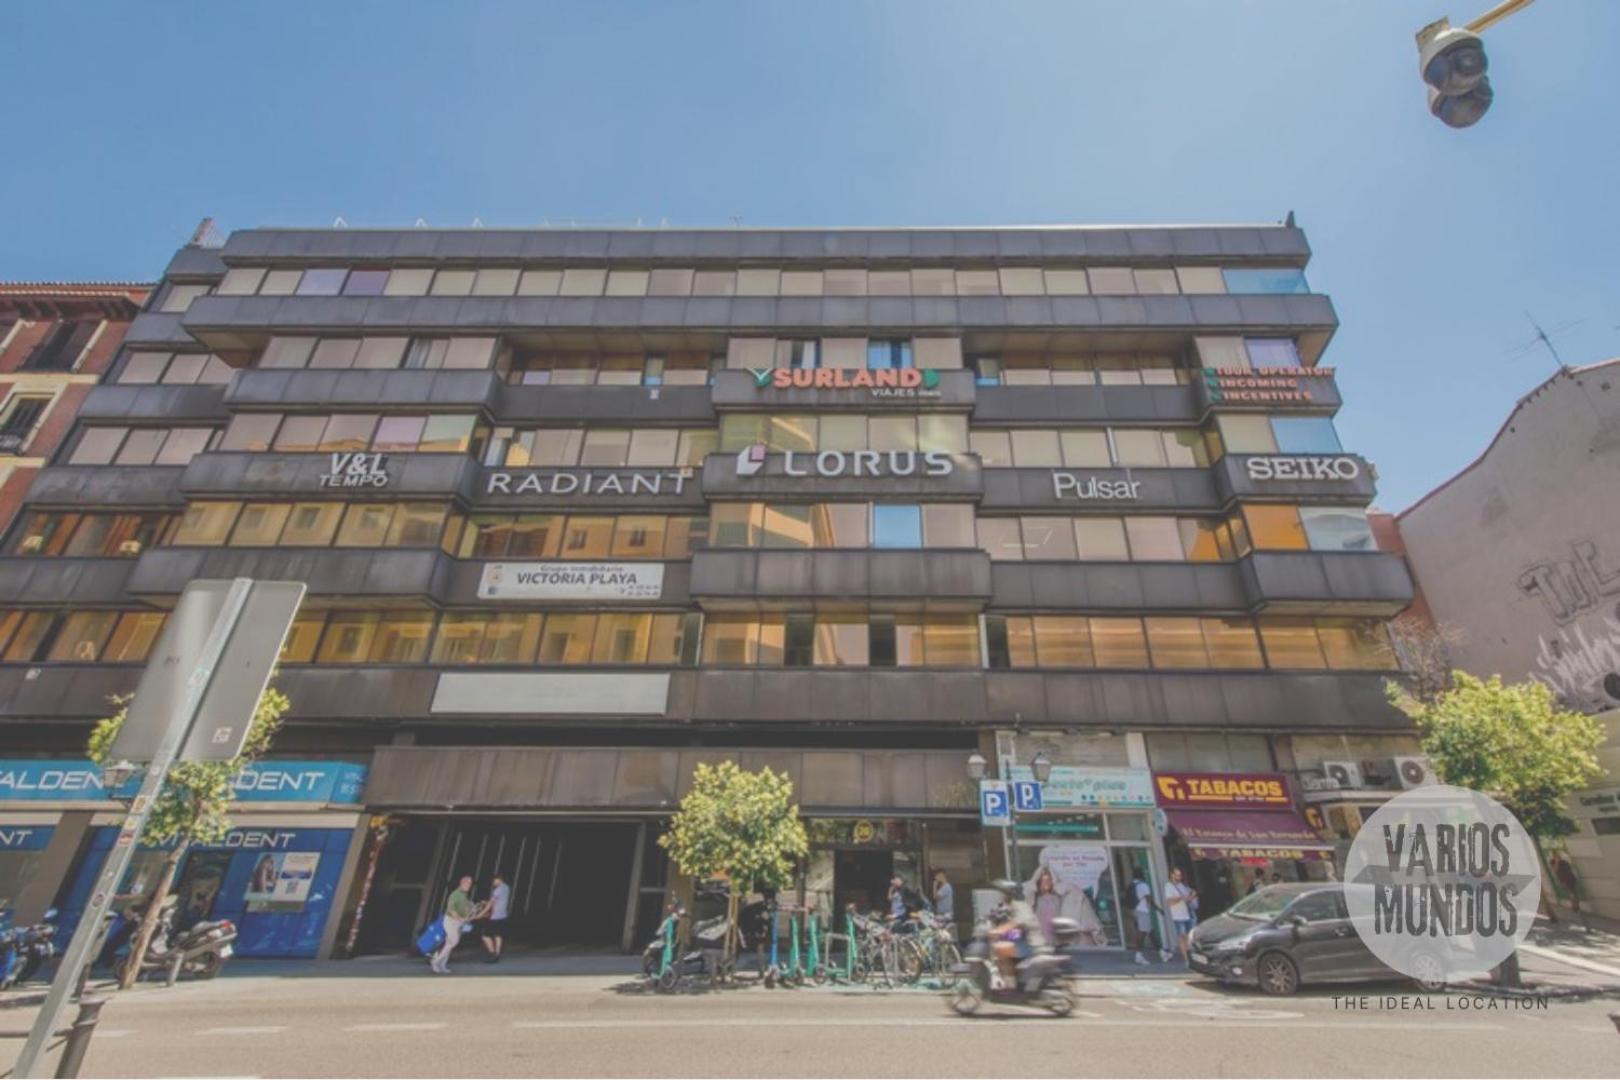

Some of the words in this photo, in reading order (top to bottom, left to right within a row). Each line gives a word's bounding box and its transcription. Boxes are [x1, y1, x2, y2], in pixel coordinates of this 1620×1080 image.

[773, 368, 921, 388] SURLAND
[1219, 379, 1297, 388] INCOMING
[871, 388, 915, 397] VIAJES
[1223, 390, 1312, 400] INCENTIVES
[330, 453, 387, 475] V&L
[784, 451, 953, 476] LORUS
[1247, 456, 1359, 480] SEIKO
[319, 475, 389, 488] TEMPO
[487, 472, 693, 494] RADIANT
[1052, 472, 1141, 499] Pulsar
[517, 572, 585, 585] VICTORIA
[589, 572, 637, 585] PLAYA
[1021, 784, 1034, 808] P
[1187, 779, 1284, 797] TABACOS
[986, 794, 1001, 814] P
[1220, 848, 1304, 860] TABACOS
